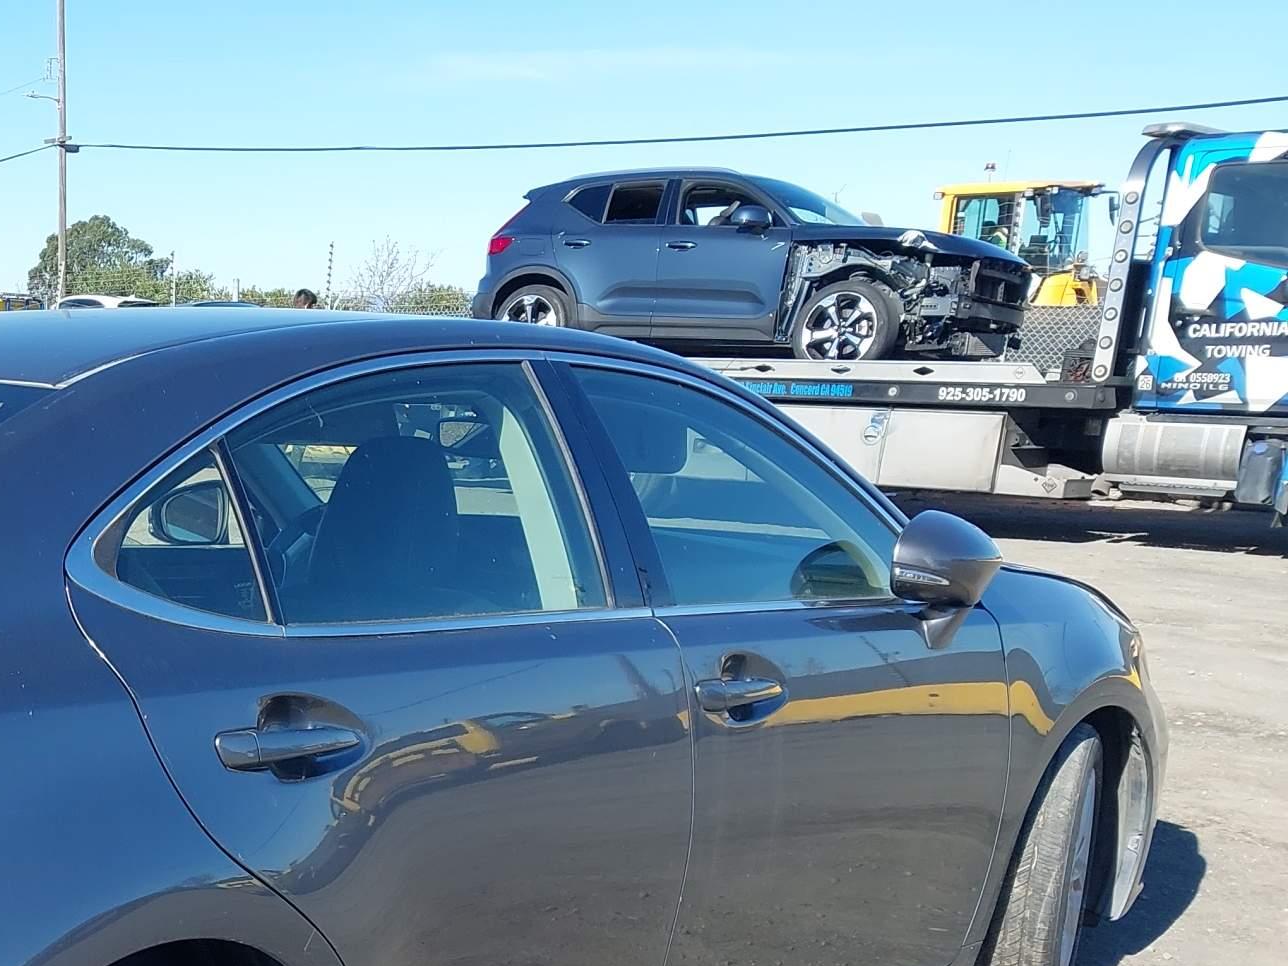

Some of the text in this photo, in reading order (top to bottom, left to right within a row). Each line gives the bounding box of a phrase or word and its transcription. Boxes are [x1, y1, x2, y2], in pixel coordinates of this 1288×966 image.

[1188, 322, 1288, 338] CALIFORNIA
[1205, 344, 1271, 358] TOWING
[790, 383, 821, 396] Concord
[1161, 382, 1201, 390] HINO
[938, 387, 1026, 402] 925-305-1790
